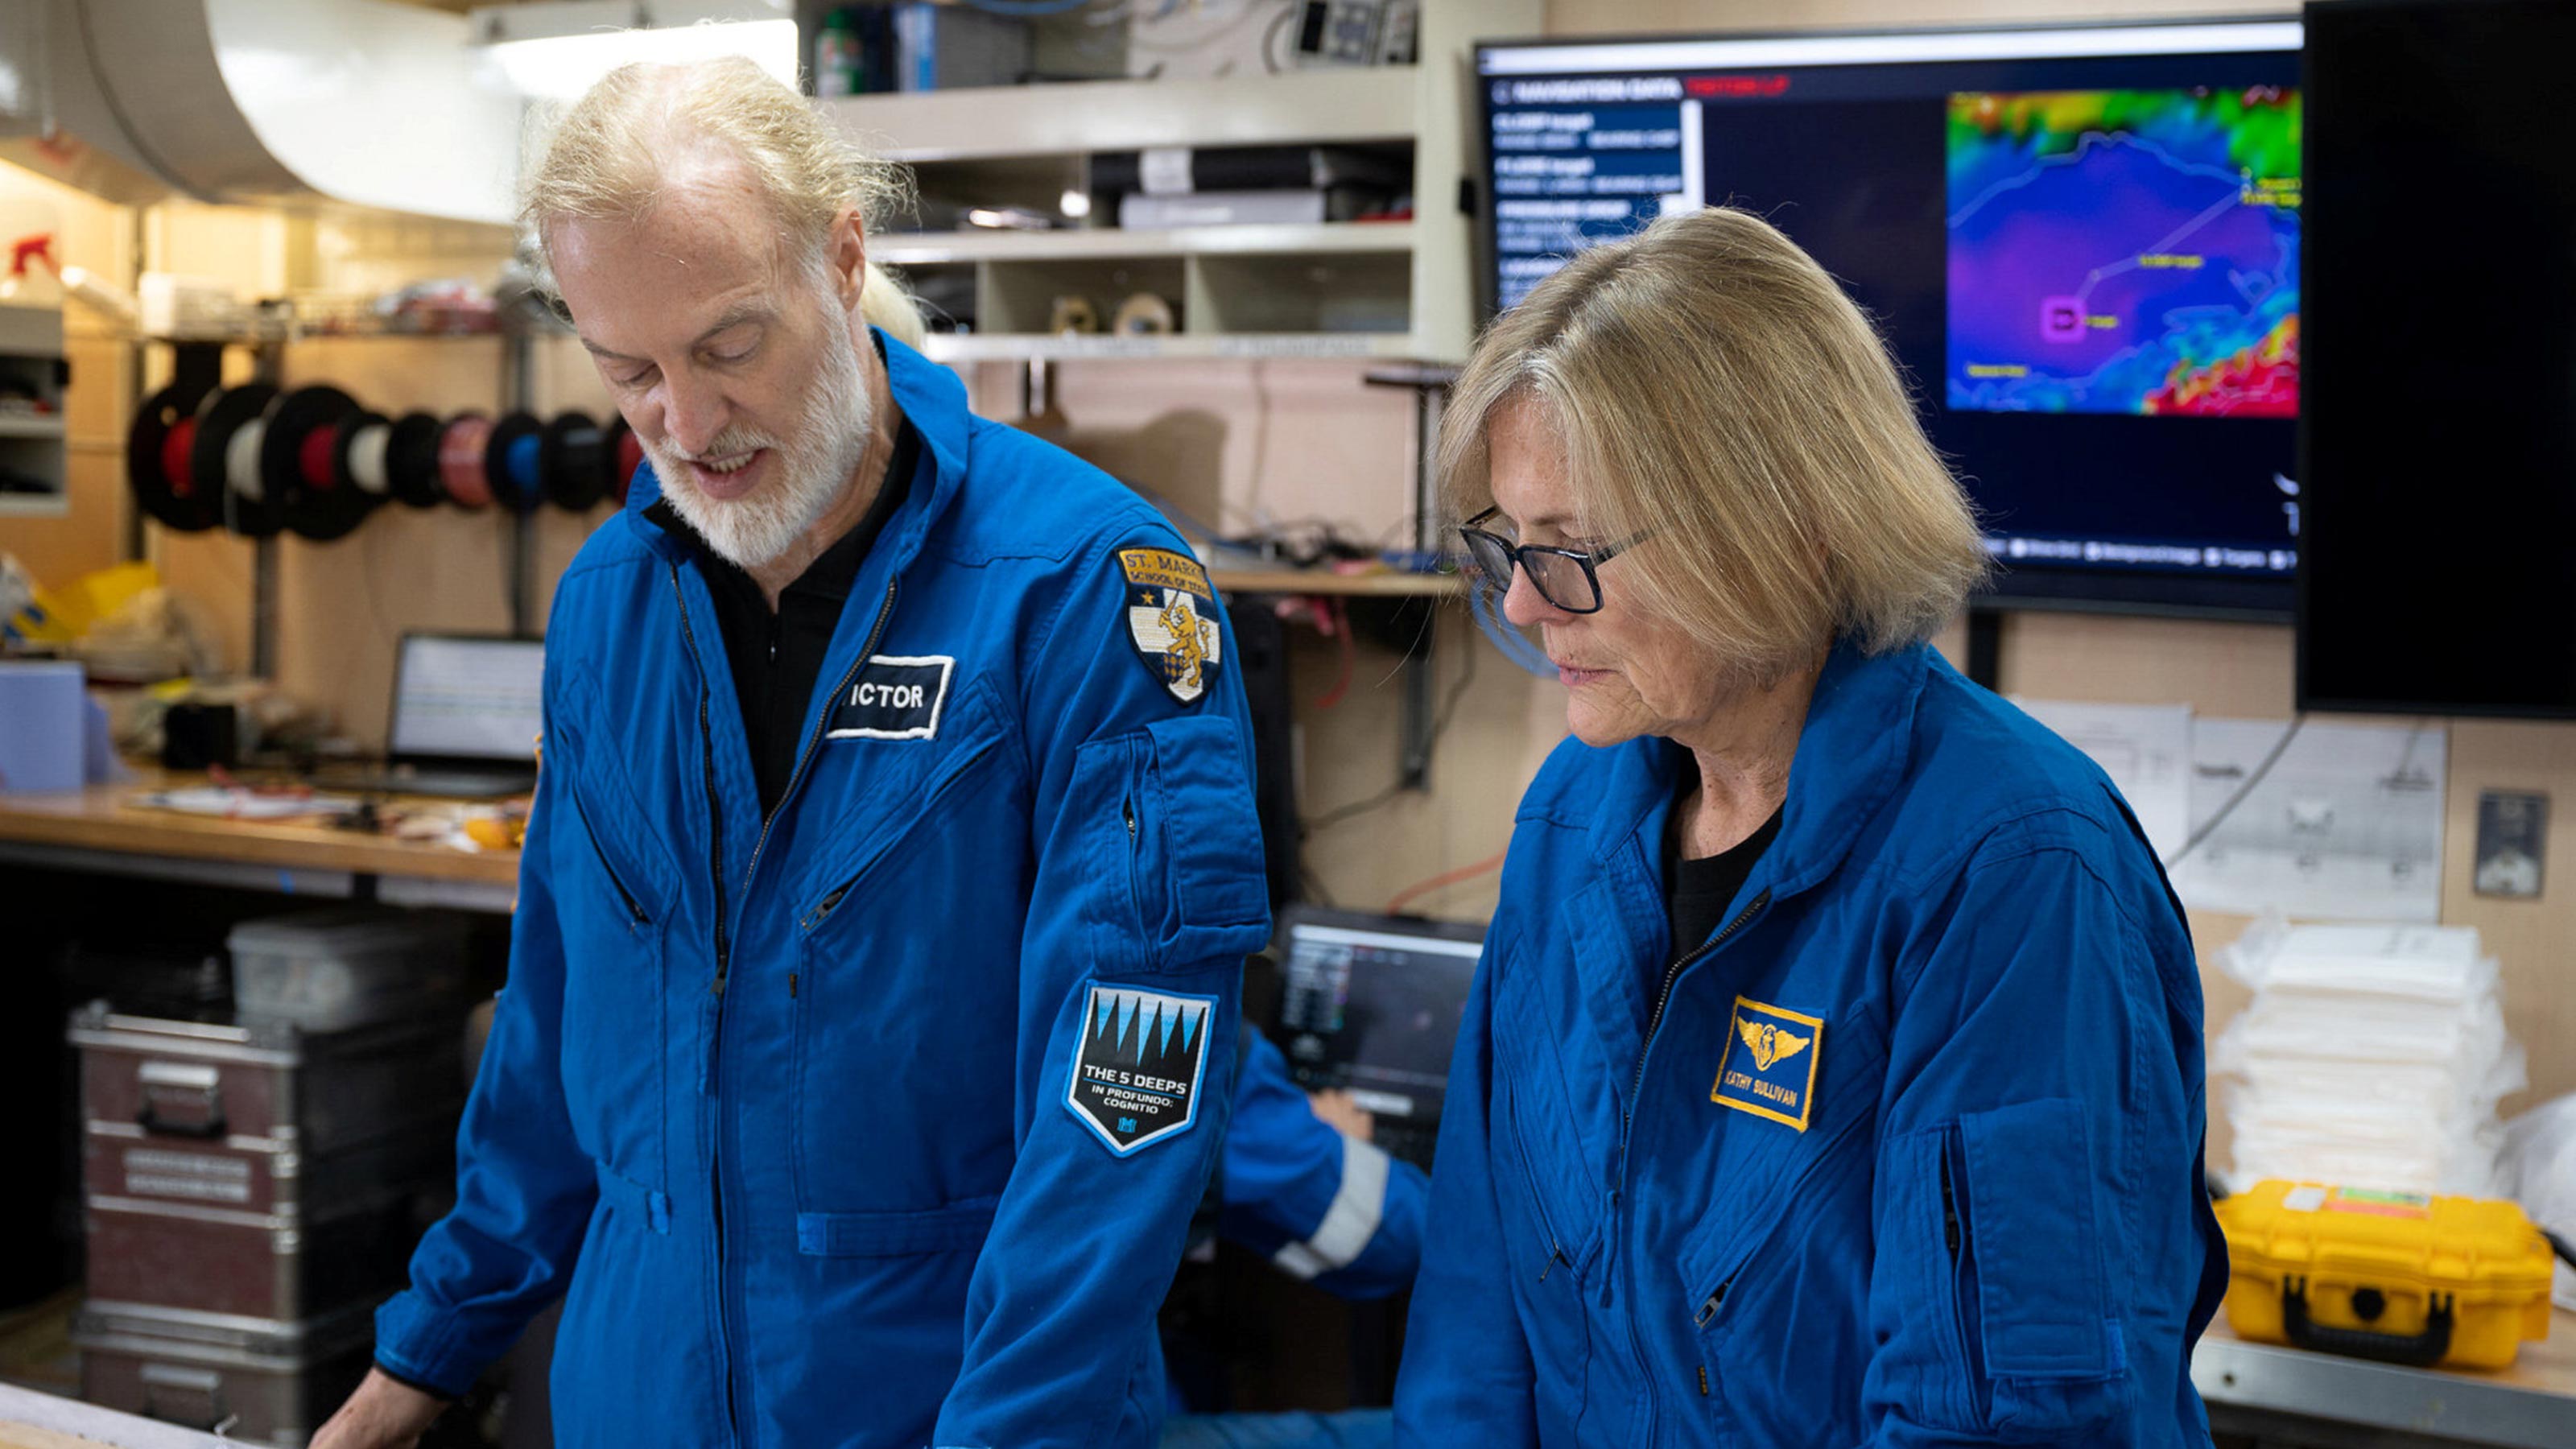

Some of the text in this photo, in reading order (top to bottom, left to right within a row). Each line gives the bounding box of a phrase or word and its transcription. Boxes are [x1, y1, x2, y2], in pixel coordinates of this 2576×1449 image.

[1125, 553, 1151, 568] ST.
[1130, 571, 1173, 584] SCHOOL
[842, 683, 923, 708] ICTOR
[1084, 1064, 1187, 1094] THE 5 DEEPS
[1092, 1084, 1105, 1095] IN
[1725, 1071, 1798, 1107] KATHY SULLIVAN
[1104, 1097, 1158, 1114] COGNITIO
